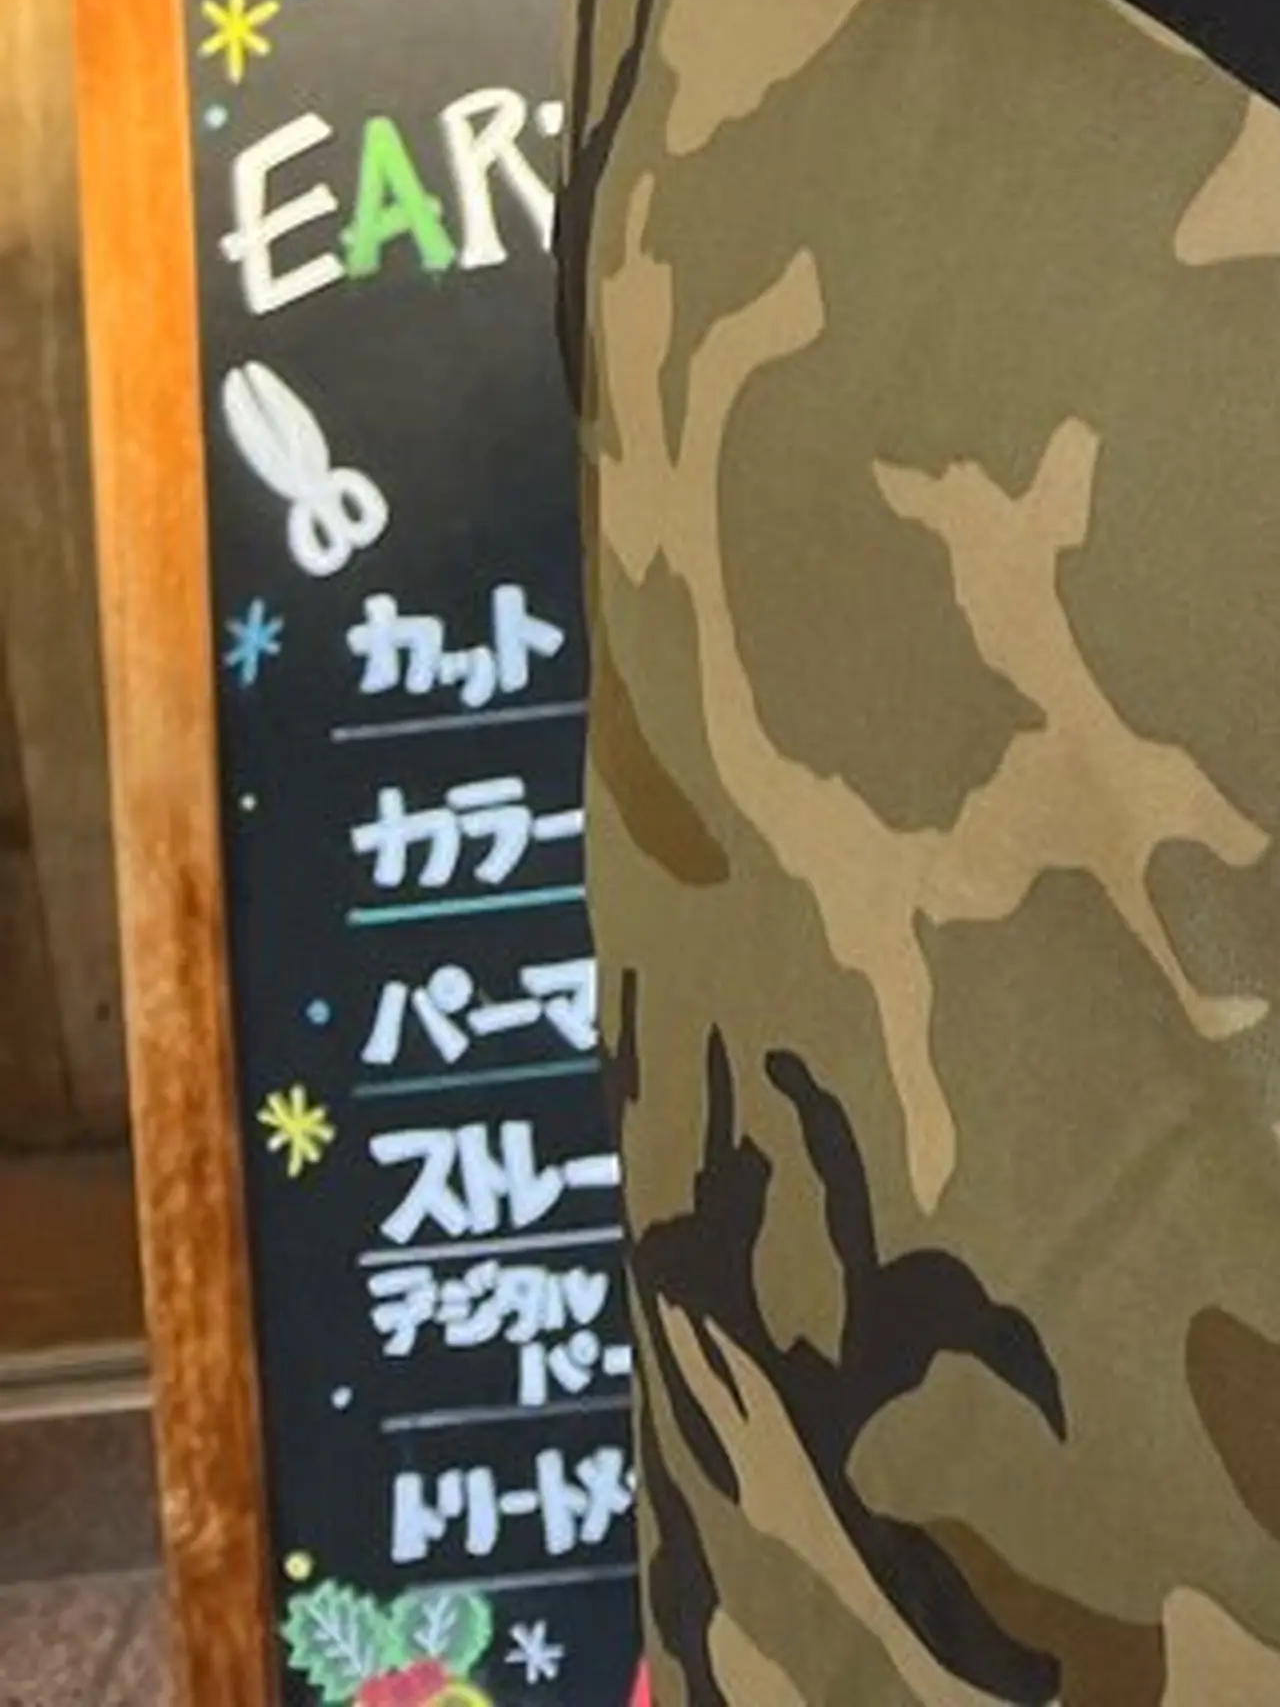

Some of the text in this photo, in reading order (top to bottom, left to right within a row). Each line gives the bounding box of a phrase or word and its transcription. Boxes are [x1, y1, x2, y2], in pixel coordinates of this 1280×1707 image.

[218, 87, 564, 316] EAR
[346, 583, 566, 708] カット
[350, 775, 586, 887] カラー
[360, 957, 599, 1065] パーマ
[368, 1119, 621, 1245] ストレー
[368, 1259, 610, 1356] デジタル
[391, 1447, 637, 1563] トリートメ
